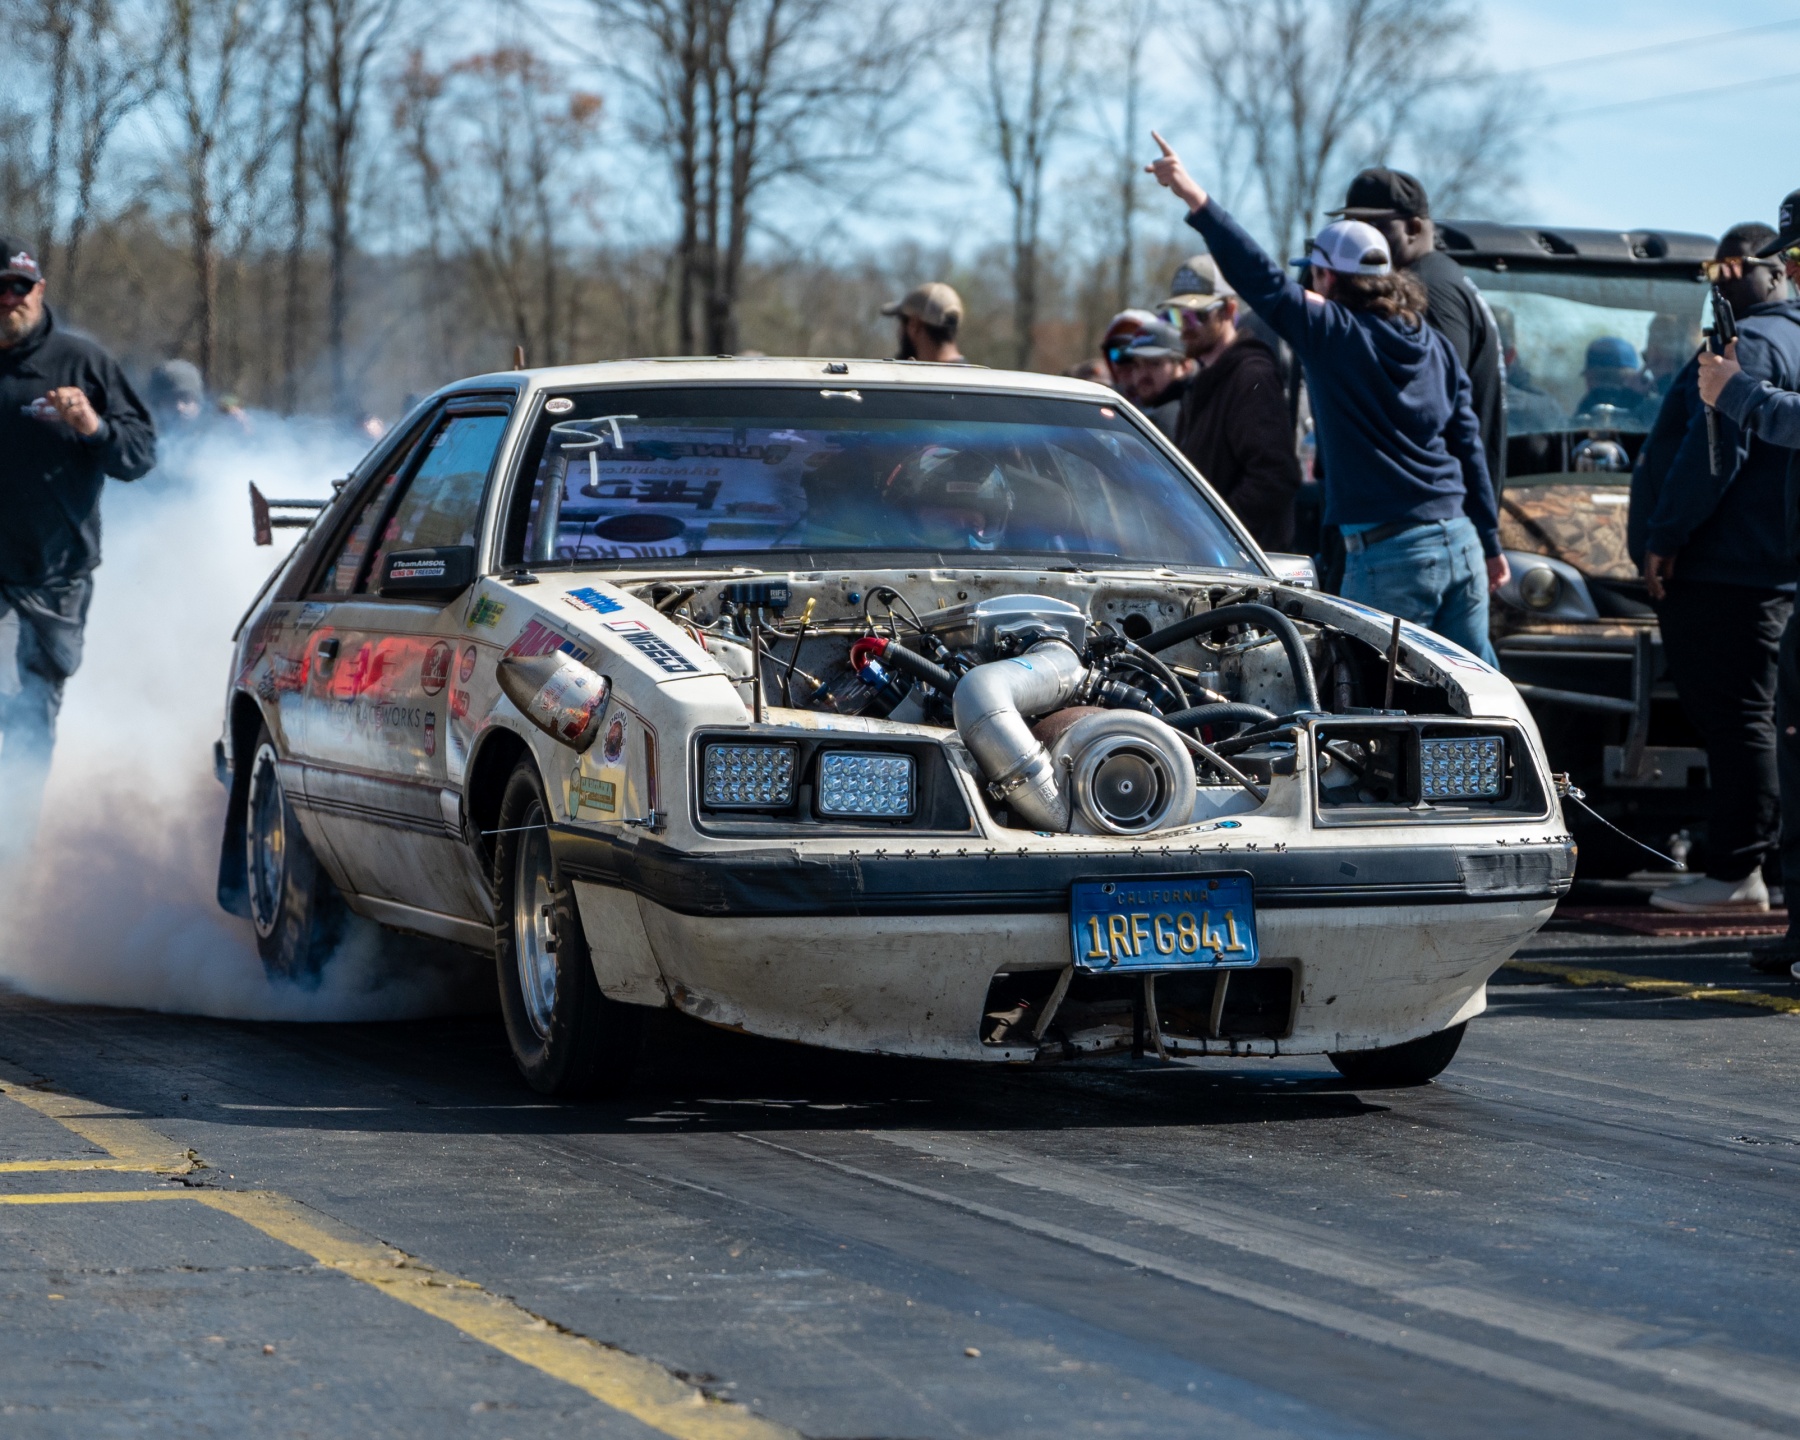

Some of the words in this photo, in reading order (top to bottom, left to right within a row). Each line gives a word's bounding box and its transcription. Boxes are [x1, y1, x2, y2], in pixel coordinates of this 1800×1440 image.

[393, 560, 446, 568] #TeamAMSOIL
[415, 568, 442, 576] FREEDOM
[770, 589, 787, 597] RIFE
[619, 630, 701, 673] WISECO
[1118, 889, 1209, 905] CALIFORNIA
[1087, 910, 1246, 958] 1RFG841
